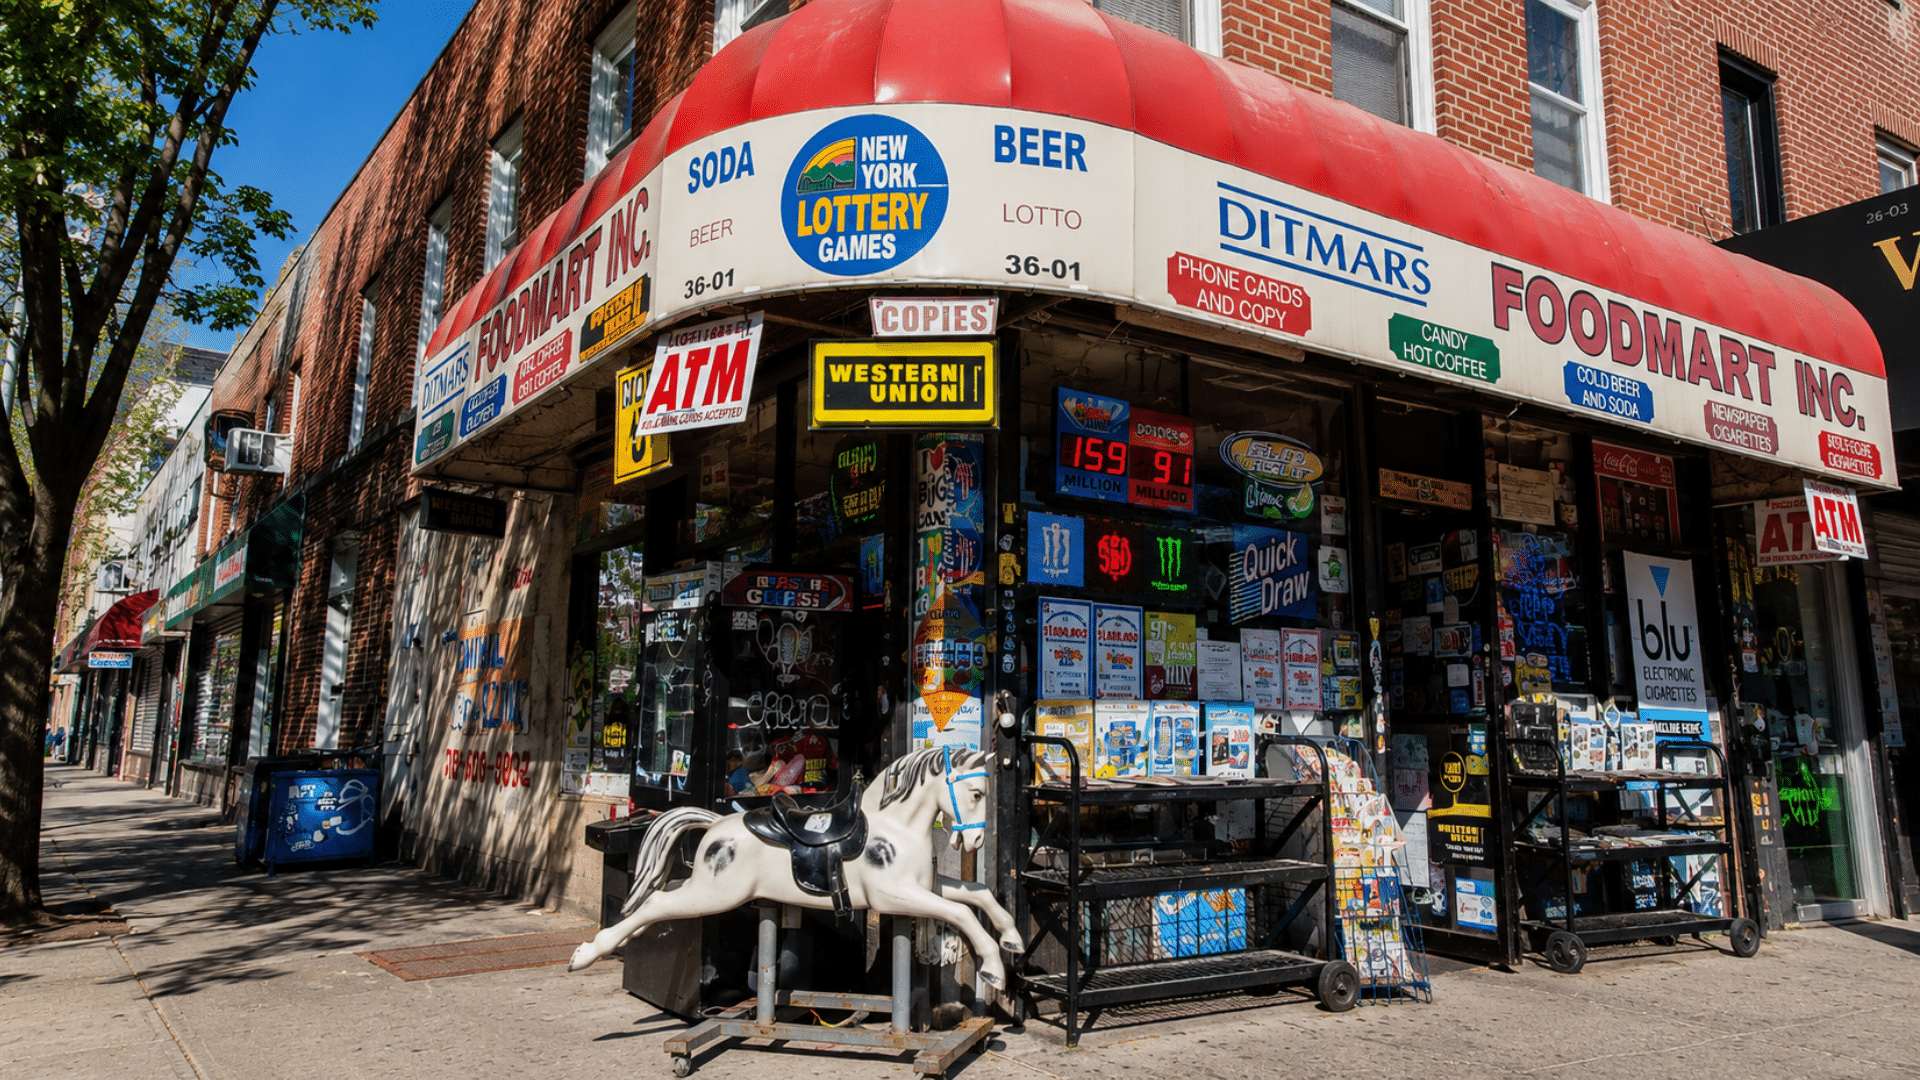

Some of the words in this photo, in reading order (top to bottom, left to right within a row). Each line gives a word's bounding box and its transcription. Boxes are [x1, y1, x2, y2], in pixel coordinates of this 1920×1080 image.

[861, 135, 908, 162] NEW
[994, 125, 1087, 172] BEER
[688, 141, 755, 194] SODA
[861, 163, 917, 189] YORK
[797, 192, 929, 237] LOTTERY
[1003, 203, 1082, 230] LOTTO
[1866, 203, 1908, 225] 26-03
[690, 218, 734, 248] BEER
[818, 233, 896, 263] GAMES
[1219, 196, 1431, 295] DITMARS
[684, 268, 735, 299] 36-01
[1005, 254, 1081, 282] 36-01
[1178, 256, 1239, 290] PHONE
[1244, 275, 1303, 308] CARDS
[475, 226, 602, 383] FOODMART
[606, 187, 650, 288] INC.
[881, 304, 988, 332] COPIES
[1197, 289, 1234, 315] AND
[1239, 300, 1286, 329] COPY
[1421, 323, 1468, 351] CANDY
[1491, 261, 1776, 405] FOODMART
[1794, 359, 1866, 431] INC.
[829, 363, 958, 382] WESTERN
[1403, 341, 1433, 366] HOT
[1435, 349, 1487, 379] COFFEE
[646, 338, 751, 414] ATM
[1576, 365, 1610, 393] COLD
[1610, 374, 1641, 400] BEER
[870, 384, 958, 402] UNION
[1582, 393, 1608, 412] AND
[1608, 398, 1641, 420] SODA
[1711, 403, 1769, 432] NEWSPAPER
[1713, 424, 1772, 452] CIGARETTES
[1074, 437, 1127, 475] 159
[1154, 451, 1191, 485] 91
[1065, 474, 1121, 492] MILLION
[1759, 511, 1818, 554] AT
[1812, 495, 1862, 544] ATM
[1243, 531, 1297, 583] Quick
[1262, 571, 1310, 615] Draw
[1638, 599, 1691, 661] blu
[1643, 666, 1696, 683] ELECTRONIC
[1645, 685, 1698, 702] CIGARETTES
